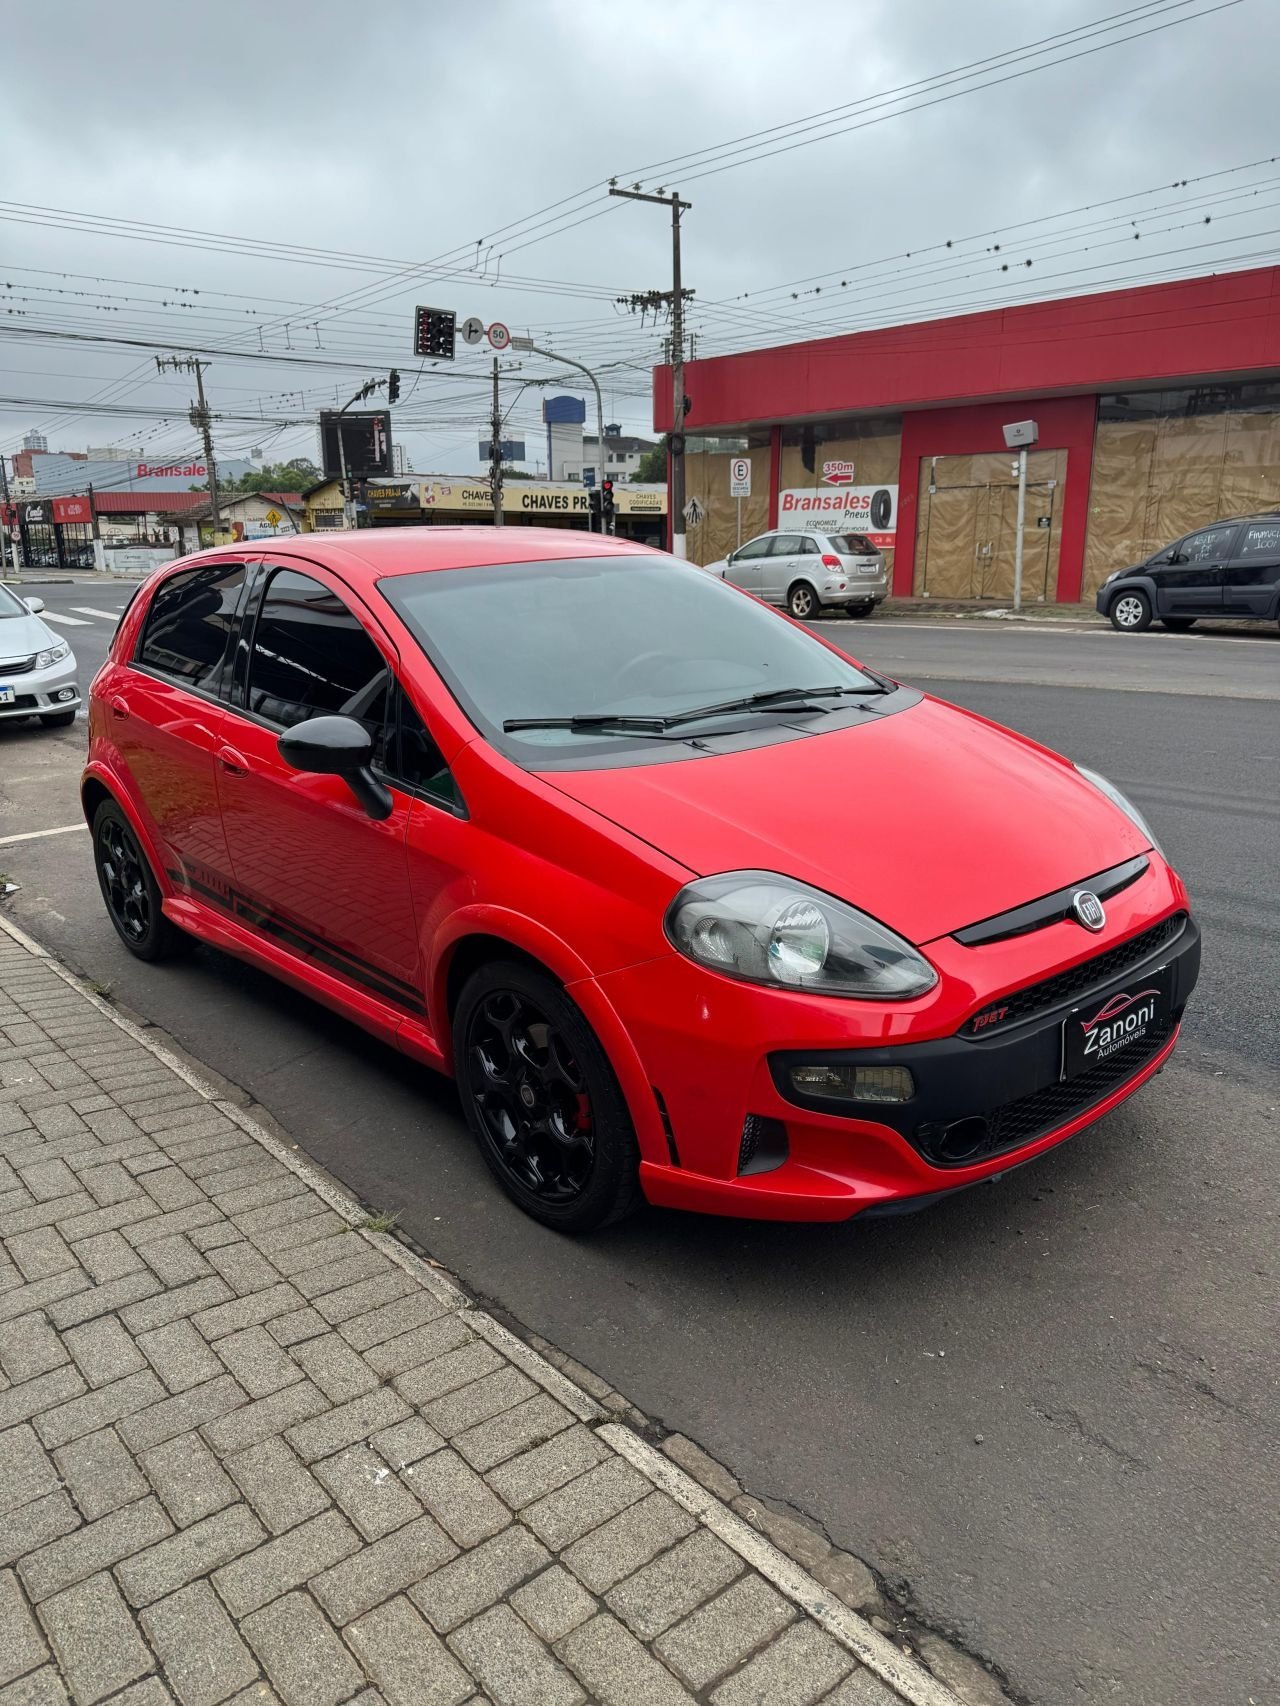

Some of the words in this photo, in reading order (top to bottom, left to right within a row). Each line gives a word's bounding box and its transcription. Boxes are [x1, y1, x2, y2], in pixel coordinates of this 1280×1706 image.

[493, 329, 504, 339] 50
[137, 463, 208, 477] Bransale
[737, 464, 744, 477] E
[823, 462, 853, 473] 350m
[522, 494, 569, 509] CHAVES
[573, 496, 590, 509] PR
[782, 491, 871, 511] Bransales
[844, 509, 870, 519] Pneus
[806, 519, 837, 527] ECONOMIZE
[1082, 900, 1101, 921] FIAT
[1083, 998, 1154, 1055] Zanoni
[1096, 1027, 1147, 1060] Automóveis
